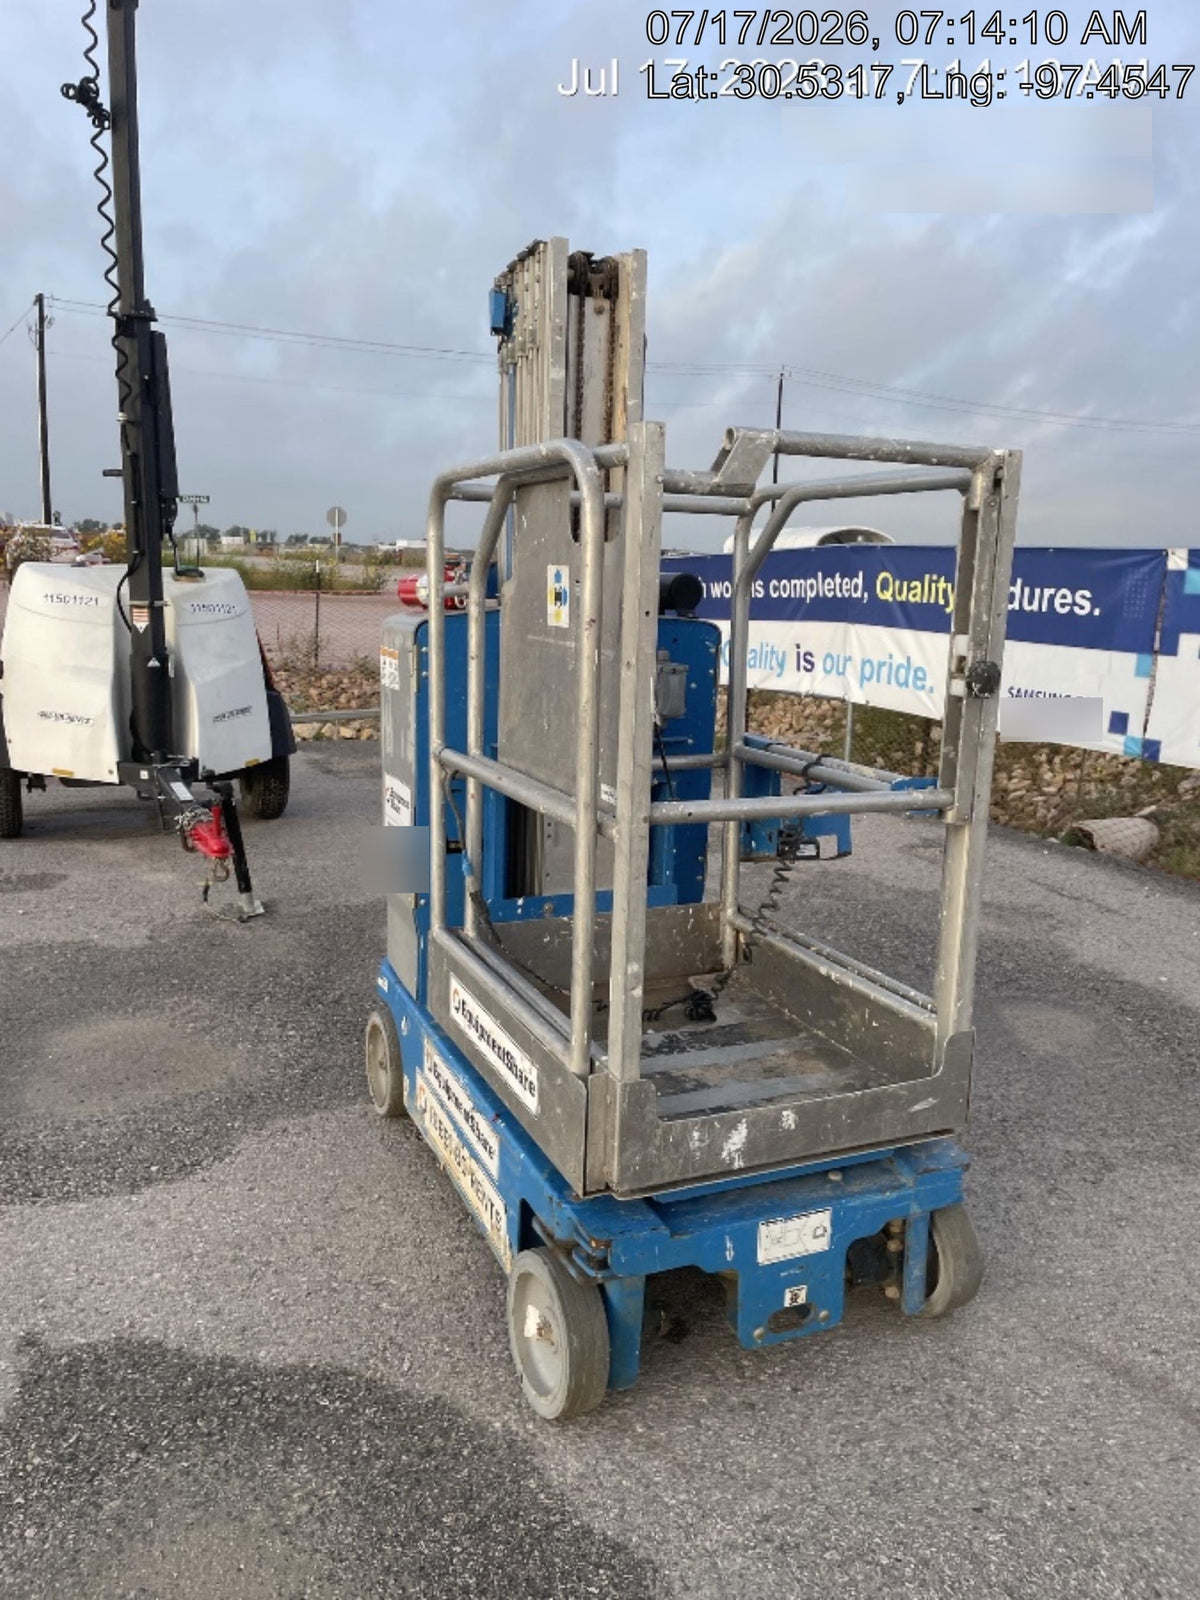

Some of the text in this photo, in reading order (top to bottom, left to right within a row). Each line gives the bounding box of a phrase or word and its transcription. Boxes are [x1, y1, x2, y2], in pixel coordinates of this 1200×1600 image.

[769, 570, 869, 604] completed,
[876, 571, 955, 613] Quality
[1008, 578, 1101, 617] dures.
[795, 643, 815, 673] is
[822, 652, 852, 677] our
[859, 654, 935, 694] pride.
